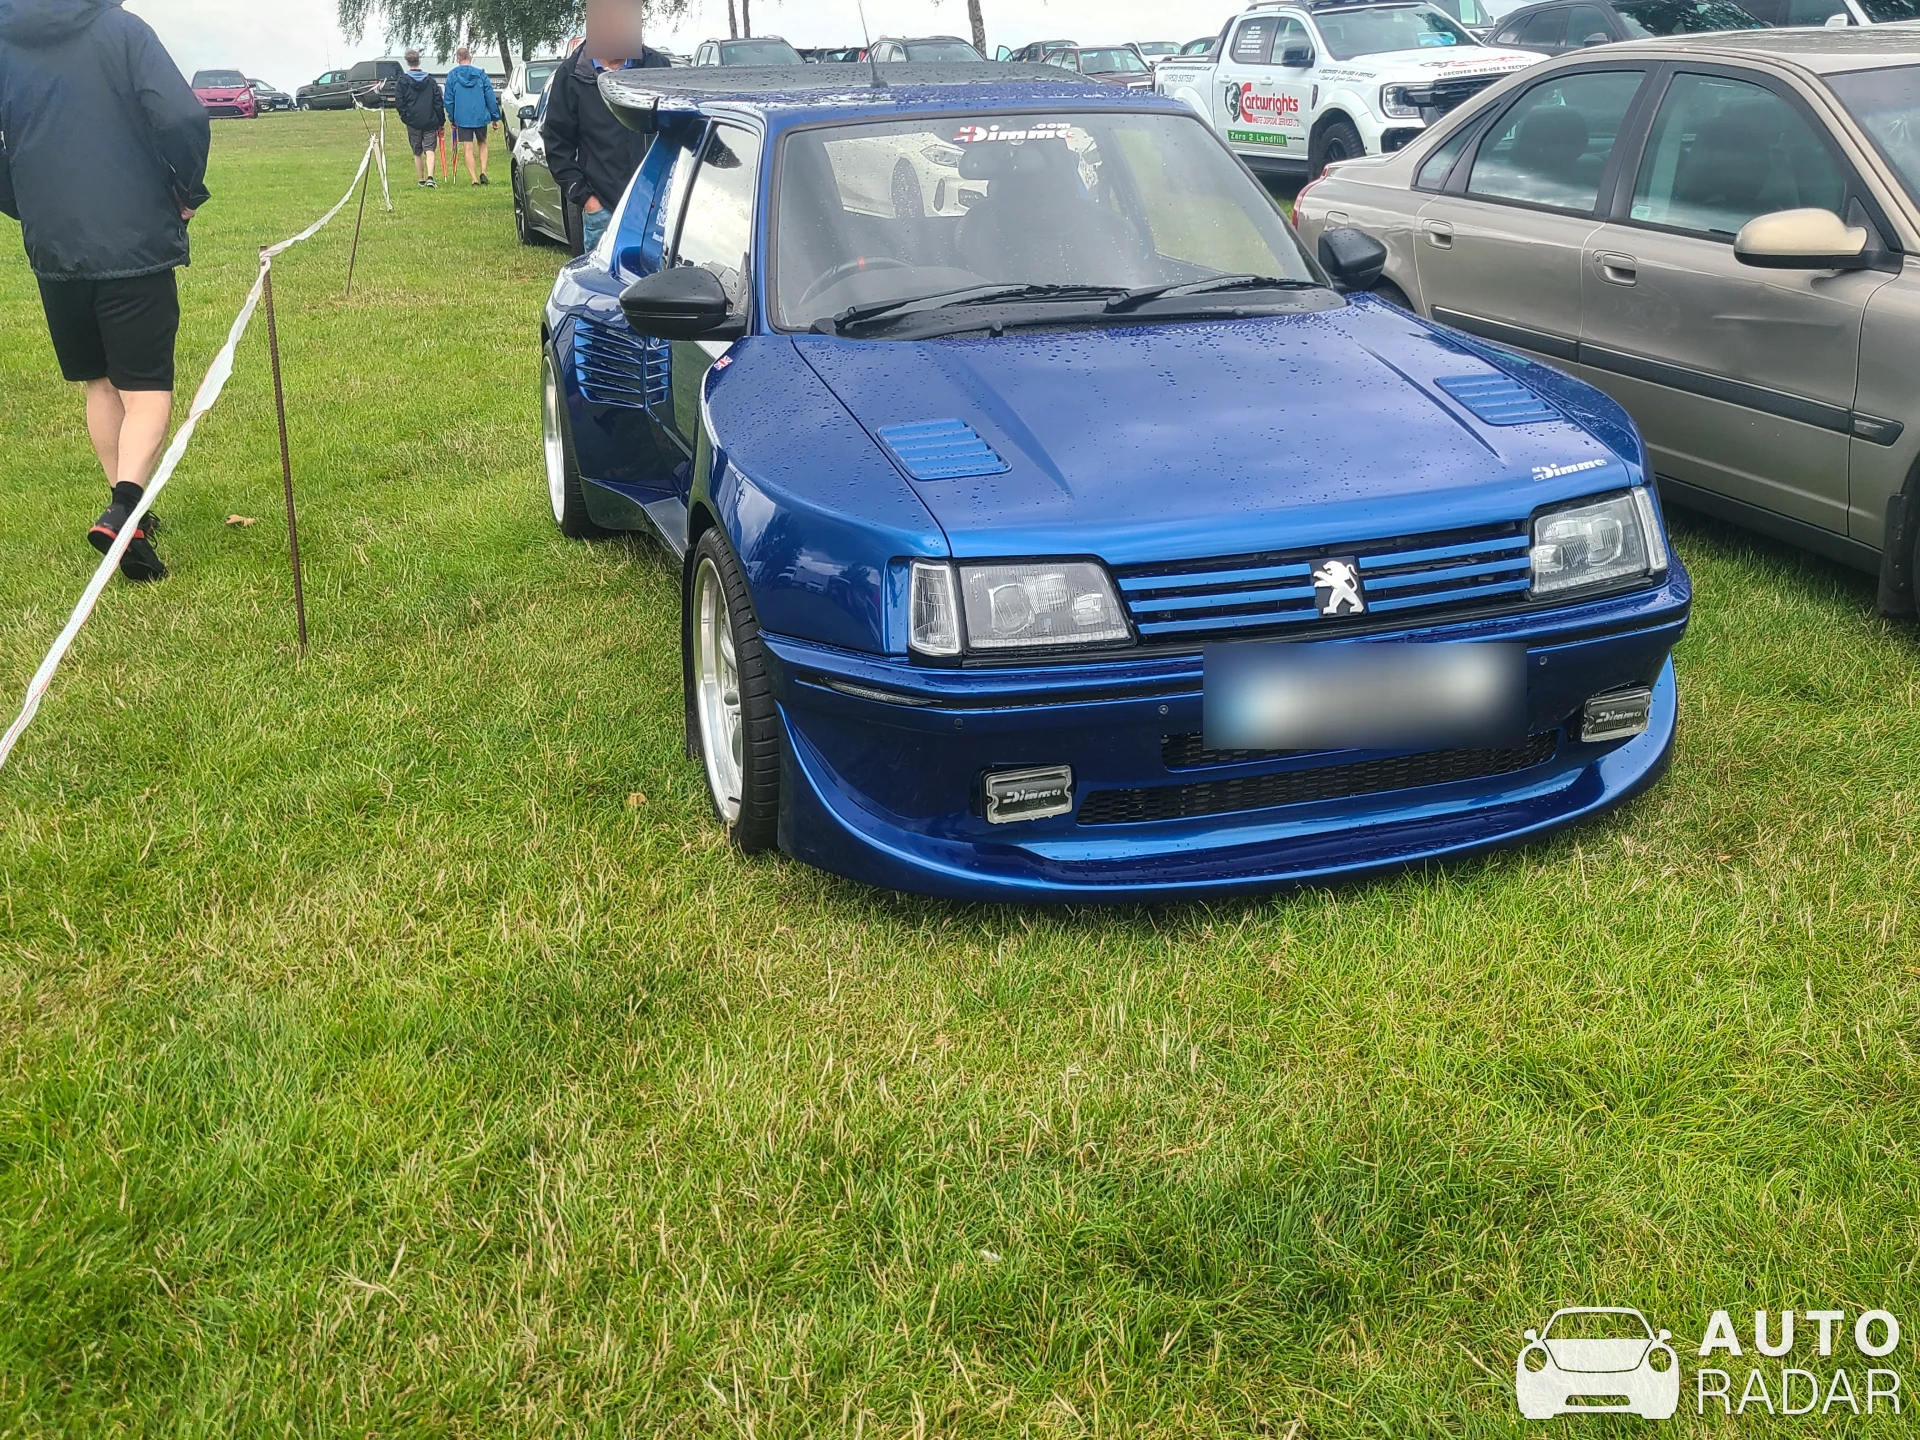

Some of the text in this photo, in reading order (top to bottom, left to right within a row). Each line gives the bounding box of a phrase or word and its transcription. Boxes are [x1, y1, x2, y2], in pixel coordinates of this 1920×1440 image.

[1443, 69, 1471, 77] RECOVER
[1240, 82, 1299, 123] Cartwrights
[1032, 122, 1072, 130] .com
[1230, 131, 1246, 141] Zero
[1248, 133, 1254, 141] 2
[1256, 134, 1284, 144] Landfill
